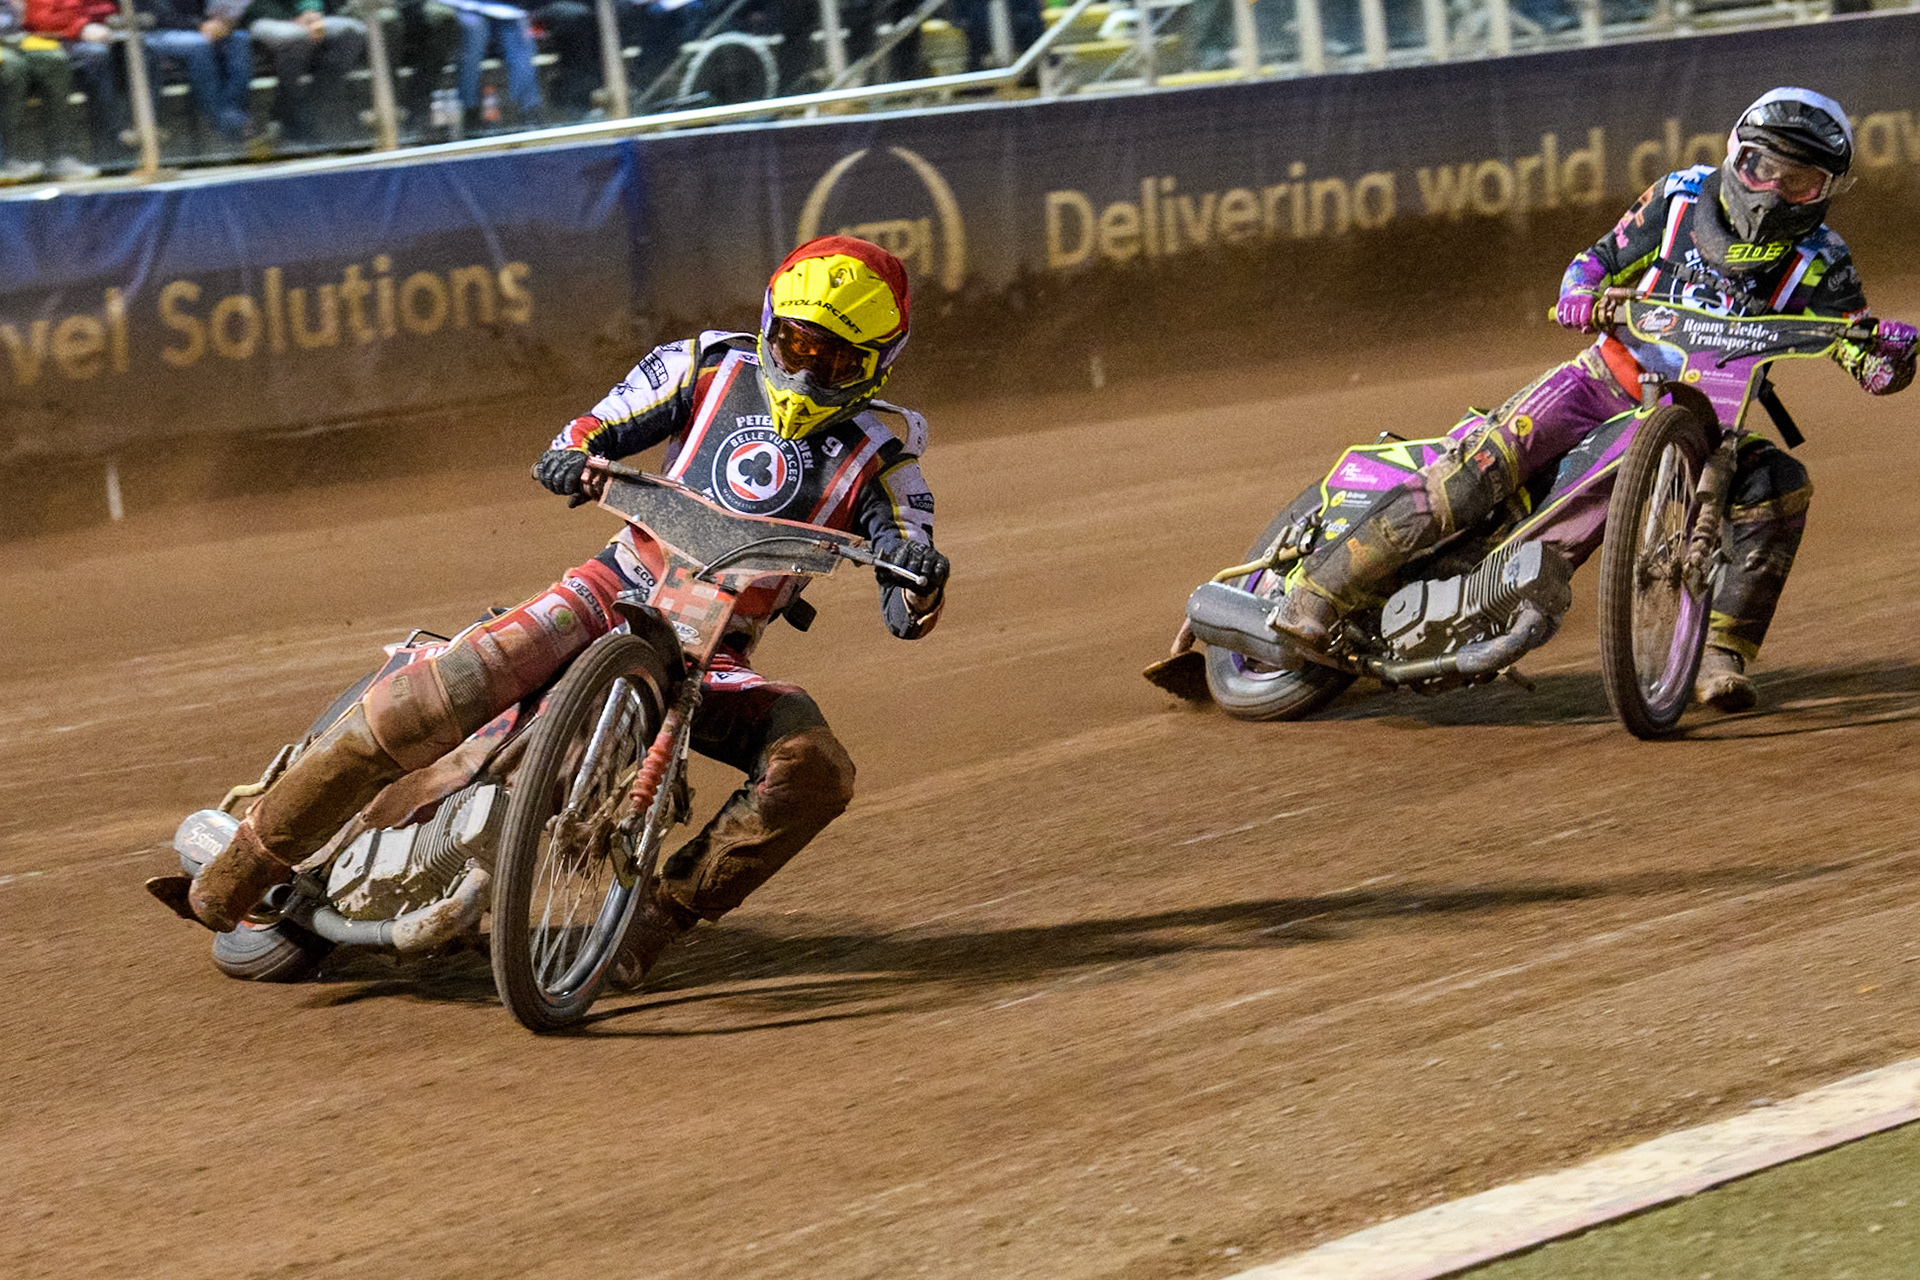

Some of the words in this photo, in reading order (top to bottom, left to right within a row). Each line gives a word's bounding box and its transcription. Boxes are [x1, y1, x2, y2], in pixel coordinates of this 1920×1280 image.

[1416, 127, 1606, 218] world
[1628, 117, 1727, 193] cla
[158, 254, 533, 367] Solutions
[779, 299, 862, 335] STOLARCENT
[1683, 318, 1727, 334] Ronny
[643, 353, 669, 386] ESER
[735, 414, 774, 428] PETE
[729, 431, 765, 448] BELLE
[769, 433, 789, 450] VUE
[785, 453, 798, 482] ACES
[633, 565, 656, 587] ECO
